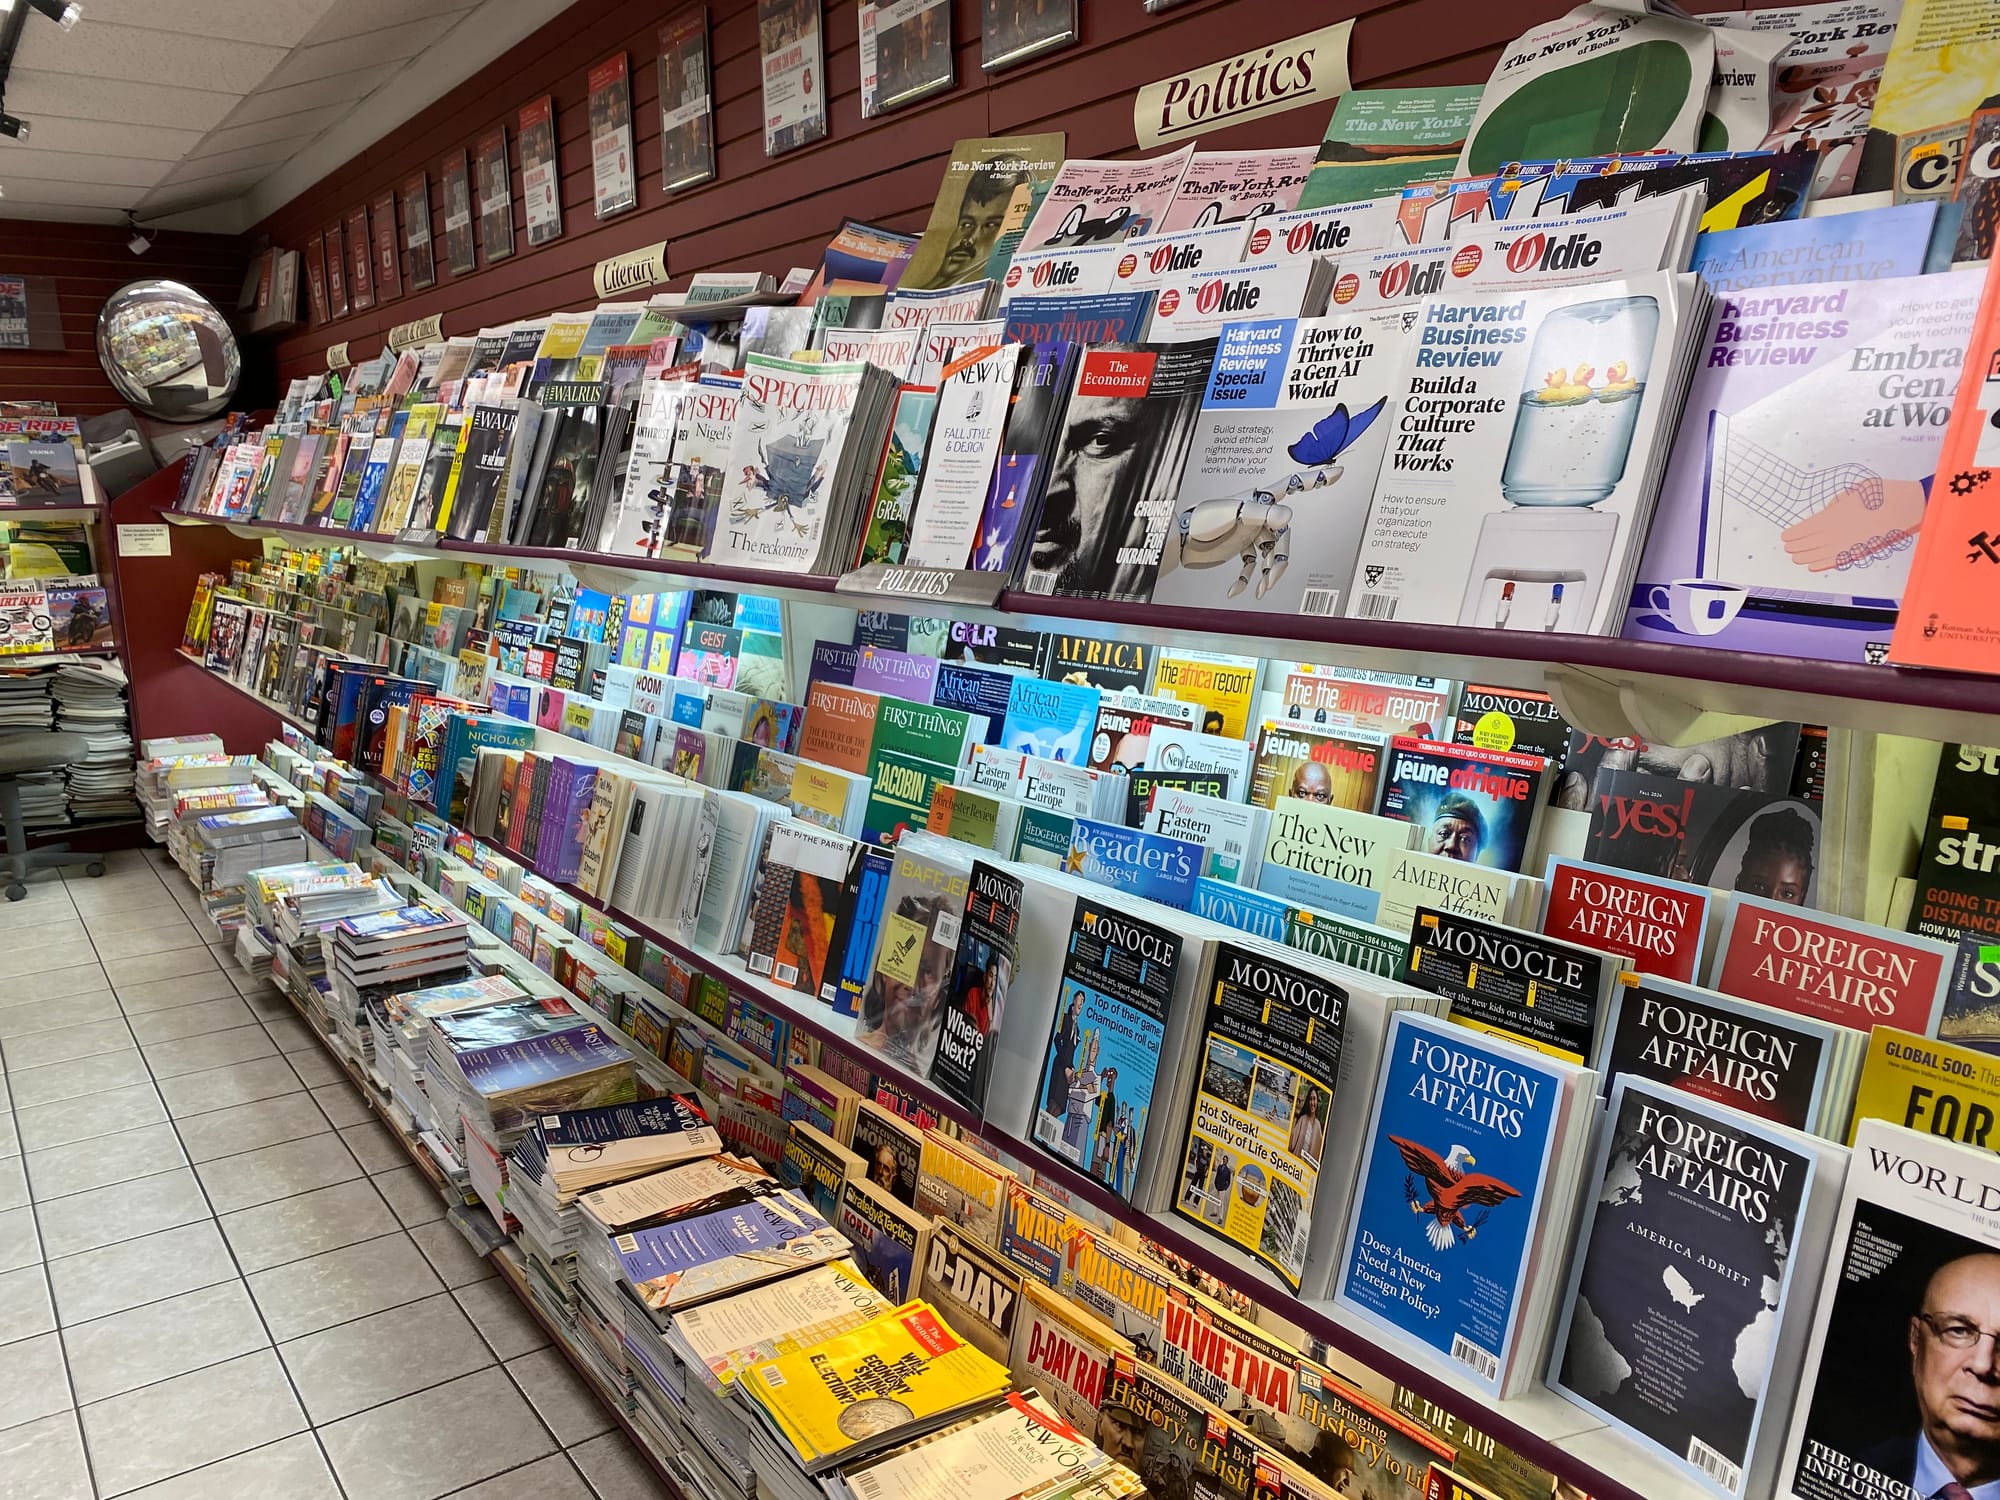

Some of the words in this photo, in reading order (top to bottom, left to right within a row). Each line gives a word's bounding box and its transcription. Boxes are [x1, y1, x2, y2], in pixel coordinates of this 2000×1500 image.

[1159, 47, 1316, 132] Politics
[1345, 119, 1380, 132] The
[1382, 119, 1420, 131] New
[1422, 116, 1463, 129] York
[951, 161, 970, 171] The
[971, 160, 993, 171] New
[994, 160, 1020, 171] York
[1019, 160, 1057, 171] Review
[1520, 166, 1543, 175] BUNS!
[1621, 161, 1659, 172] ORANGES
[1287, 221, 1351, 254] Oldie
[1503, 223, 1523, 232] WEEP
[1525, 222, 1542, 231] FOR
[1543, 220, 1569, 229] WALES
[1494, 241, 1510, 251] The
[1506, 232, 1602, 274] Oldie
[602, 257, 657, 290] Literary
[1196, 278, 1260, 314] Oldie
[1426, 300, 1527, 323] Harvard
[1721, 289, 1849, 319] Harvard
[1226, 326, 1281, 342] Harvard
[1301, 327, 1339, 345] How
[1341, 325, 1362, 341] to
[1421, 324, 1527, 345] Business
[1714, 317, 1849, 343] Business
[1218, 356, 1267, 371] Review
[1223, 341, 1281, 357] Business
[1297, 344, 1349, 364] Thrive
[1415, 342, 1503, 368] Review
[1707, 342, 1818, 368] Review
[1084, 374, 1147, 386] Economist
[1109, 361, 1129, 373] The
[1214, 371, 1265, 388] Special
[1303, 363, 1336, 380] Gen
[554, 385, 601, 402] WALRUS
[1211, 387, 1247, 400] Issue
[1288, 380, 1338, 400] World
[1409, 377, 1457, 394] Build
[1405, 397, 1506, 418] Corporate
[696, 422, 733, 444] Nigel's
[1400, 416, 1475, 433] Culture
[1397, 434, 1445, 452] That
[1200, 465, 1218, 475] work
[1238, 466, 1266, 475] evolve
[1393, 453, 1453, 473] Works
[1134, 500, 1175, 517] CRUNCH
[1145, 517, 1171, 533] TIME
[1116, 547, 1160, 566] UKRAINE
[876, 569, 954, 595] POLITICS
[700, 630, 727, 649] GEIST
[951, 620, 998, 649] G&LR
[557, 657, 578, 670] WORLD
[893, 657, 932, 681] THINGS
[1057, 637, 1144, 670] AFRICA
[555, 667, 577, 680] RECORDS
[940, 670, 980, 694] African
[1179, 663, 1213, 689] africa
[1213, 671, 1252, 696] report
[812, 691, 842, 712] FIRST
[843, 695, 877, 720] THINGS
[936, 686, 978, 705] BUSINESS
[1008, 702, 1058, 721] BUSINESS
[1013, 683, 1060, 709] African
[1385, 695, 1440, 724] report
[1464, 692, 1560, 720] MONOCLE
[884, 705, 913, 729] FIRST
[914, 712, 963, 737] THINGS
[468, 730, 526, 747] NICHOLAS
[1311, 741, 1375, 774] afrique
[873, 761, 928, 803] JACOBIN
[1393, 757, 1449, 786] jeune
[1450, 764, 1530, 801] afrique
[1608, 788, 1695, 842] yes!
[1025, 823, 1070, 846] HEDGEHOG
[1074, 820, 1192, 877] Reader's
[1278, 812, 1316, 844] The
[1321, 823, 1376, 858] New
[1087, 856, 1140, 885] Digest
[1270, 839, 1373, 888] Criterion
[1392, 859, 1501, 907] AMERICAN
[1567, 875, 1690, 929] FOREIGN
[1567, 907, 1678, 957] AFFAIRS
[1290, 923, 1403, 980] MONTHLY
[1426, 925, 1584, 990] MONOCLE
[1751, 917, 1919, 987] FOREIGN
[1751, 953, 1899, 1018] AFFAIRS
[1956, 952, 1972, 992] Watershed
[1228, 958, 1343, 1027] MONOCLE
[947, 1005, 985, 1051] Where
[1085, 1007, 1134, 1041] Champions
[1134, 1031, 1148, 1045] roll
[1148, 1037, 1160, 1052] call
[1094, 993, 1109, 1011] Top
[1110, 1001, 1121, 1014] of
[1121, 1007, 1141, 1025] their
[1141, 1017, 1162, 1038] game:
[1533, 1013, 1555, 1032] block
[940, 1029, 977, 1072] Next?
[1638, 998, 1799, 1072] FOREIGN
[1409, 1036, 1541, 1109] FOREIGN
[1638, 1034, 1780, 1103] AFFAIRS
[1885, 1041, 1938, 1070] GLOBAL
[1942, 1058, 1976, 1080] 500:
[1199, 1100, 1220, 1120] Hot
[1220, 1110, 1260, 1139] Streak!
[1409, 1073, 1524, 1139] AFFAIRS
[1197, 1115, 1235, 1145] Quality
[1235, 1136, 1249, 1151] of
[1248, 1139, 1269, 1160] Life
[1269, 1151, 1304, 1183] Special
[1635, 1104, 1790, 1192] FOREIGN
[784, 1139, 814, 1171] BRITISH
[813, 1162, 842, 1195] ARMY
[921, 1135, 997, 1209] WARSHIPS
[1868, 1146, 2000, 1212] WORLD
[919, 1174, 949, 1200] ARCTIC
[1635, 1144, 1771, 1225] AFFAIRS
[843, 1208, 875, 1243] KOREA
[846, 1184, 914, 1247] Strategy&Tactics
[1358, 1246, 1388, 1274] Need
[1399, 1266, 1426, 1292] New
[1362, 1229, 1391, 1256] Does
[1392, 1247, 1442, 1283] America
[1626, 1221, 1693, 1259] AMERICA
[1697, 1254, 1751, 1288] ADRIFT
[928, 1237, 1014, 1330] D-DAY
[1355, 1263, 1398, 1297] Foreign
[1400, 1290, 1441, 1320] Policy?
[910, 1315, 945, 1354] Economist
[1223, 1323, 1251, 1343] COMPLETE
[1252, 1336, 1271, 1355] GUIDE
[862, 1353, 915, 1396] ECONOMY
[1301, 1372, 1322, 1389] NEW
[1110, 1376, 1184, 1445] History
[1141, 1379, 1189, 1424] Bringing
[1298, 1391, 1385, 1468] History
[1331, 1397, 1388, 1446] Bringing
[1398, 1405, 1415, 1420] SECOND
[1415, 1414, 1433, 1432] EDITION
[1398, 1386, 1415, 1410] IN
[1423, 1399, 1457, 1437] THE
[1462, 1424, 1497, 1461] AIR
[1809, 1439, 1850, 1472] THE
